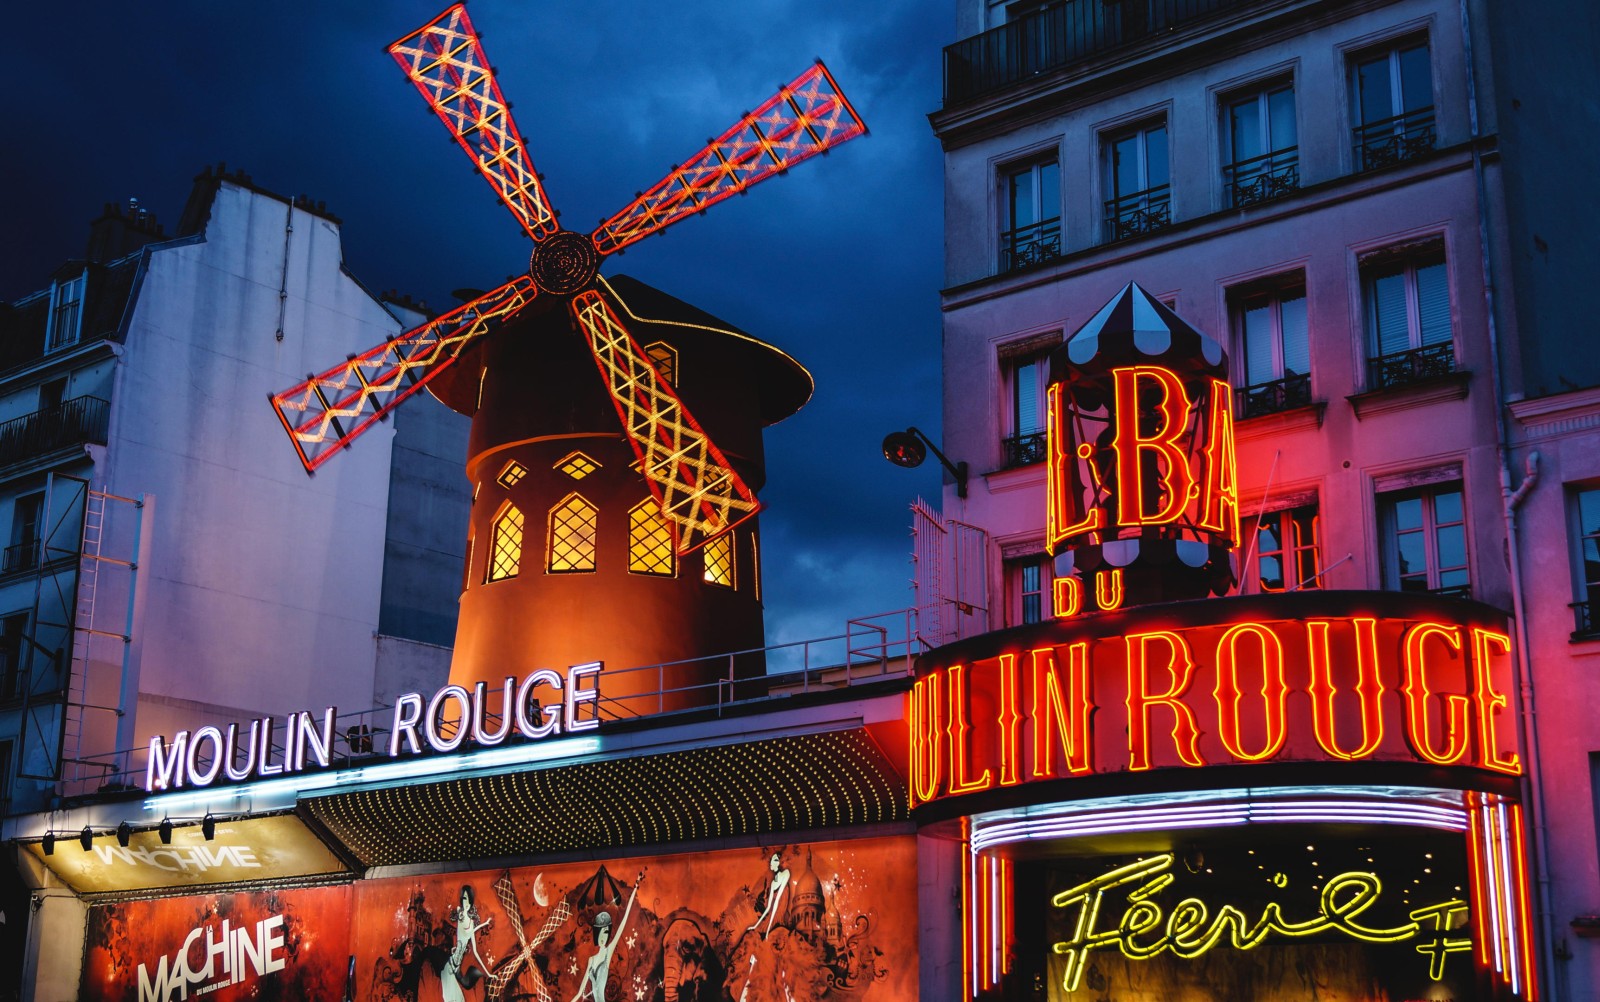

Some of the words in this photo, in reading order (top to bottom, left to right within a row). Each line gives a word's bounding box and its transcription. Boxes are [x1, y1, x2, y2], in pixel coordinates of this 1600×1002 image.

[1053, 569, 1122, 618] DU
[145, 706, 337, 793] MOULIN
[389, 660, 605, 757] ROUGE
[907, 640, 1094, 808] ULIN
[1125, 616, 1523, 777] ROUGE
[137, 914, 286, 1002] MACHINE
[1051, 852, 1420, 993] Féerie
[196, 988, 203, 996] DU
[202, 983, 217, 994] MOULIN
[217, 979, 231, 989] ROUGE
